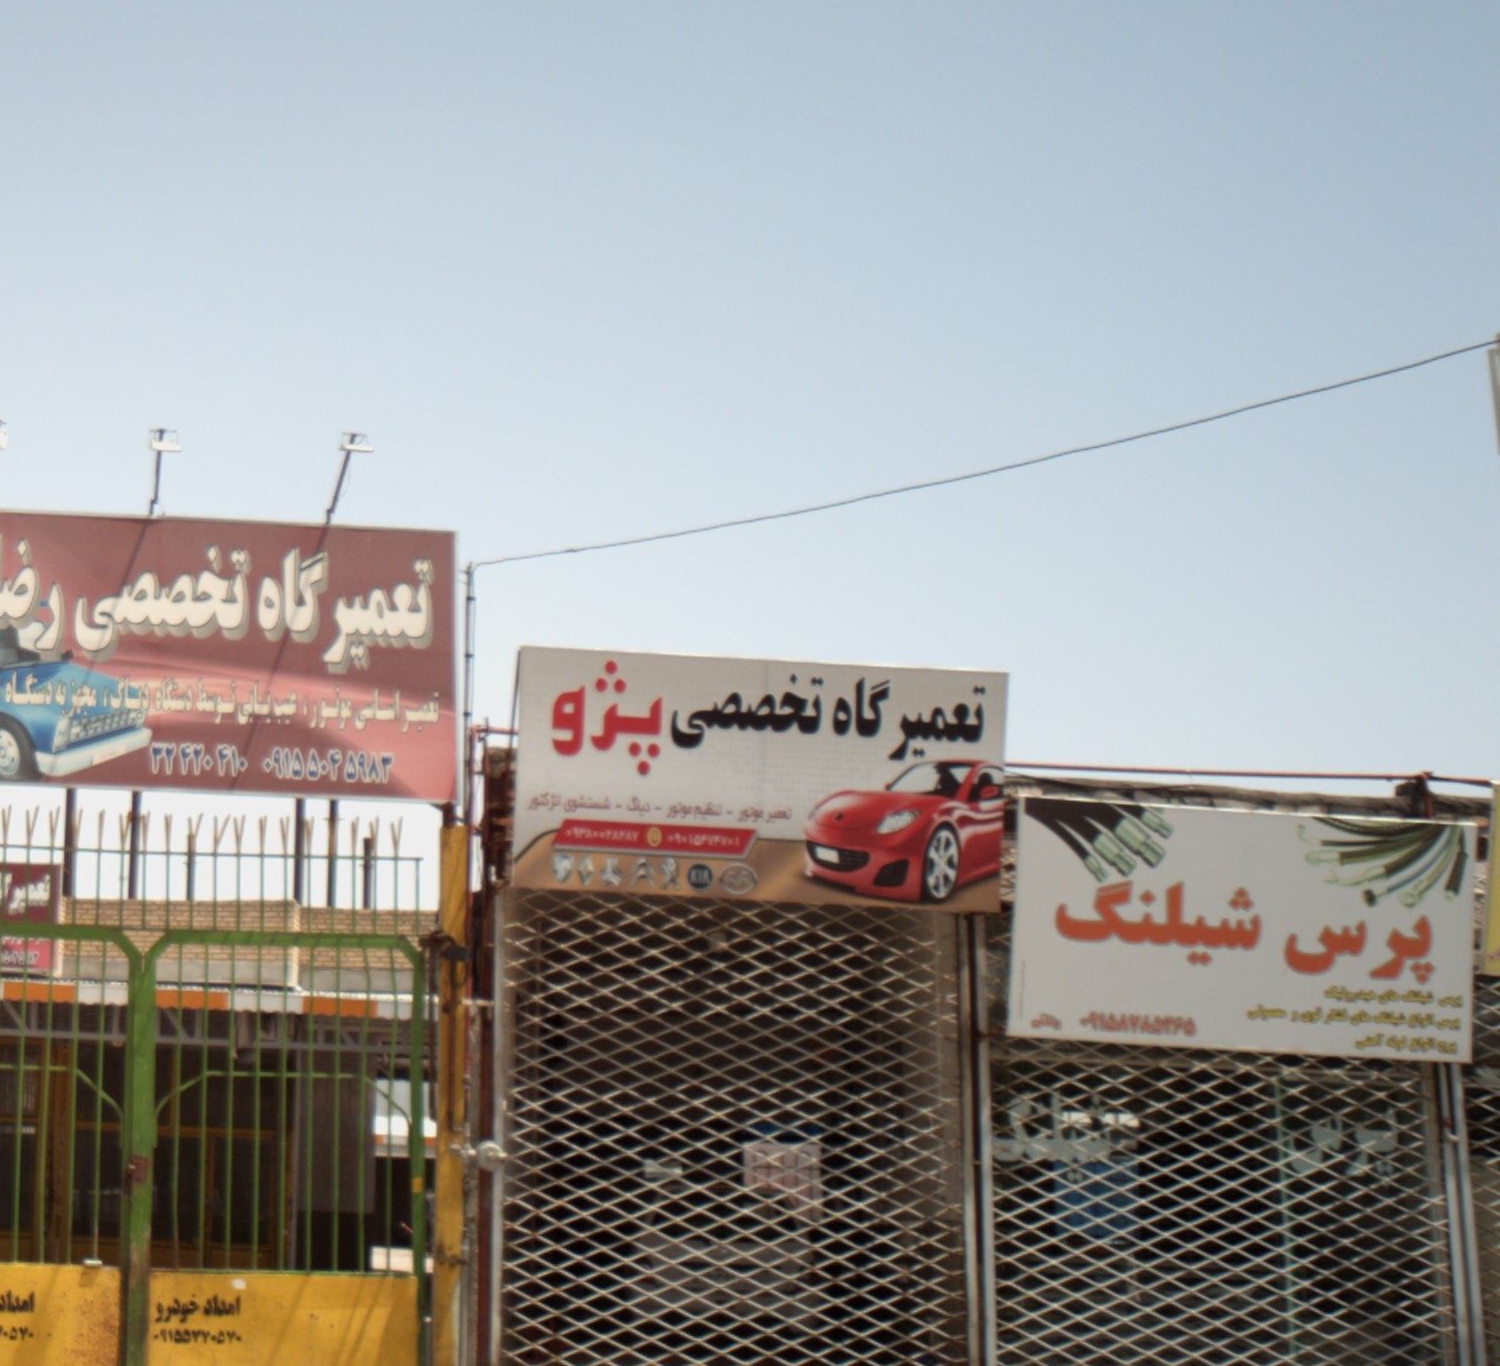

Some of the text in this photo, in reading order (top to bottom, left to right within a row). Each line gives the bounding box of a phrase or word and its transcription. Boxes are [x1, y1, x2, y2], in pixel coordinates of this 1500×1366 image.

[75, 542, 251, 660] تخصصی
[5, 670, 53, 706] دستگاه
[155, 677, 193, 712] دستگاه
[196, 679, 236, 725] توسط
[355, 688, 400, 730] اساسی
[670, 672, 824, 749] تخصصی
[551, 658, 663, 776] پژو
[1054, 878, 1436, 985] پرس شیلنگ
[155, 1293, 241, 1323] امداد خودرو
